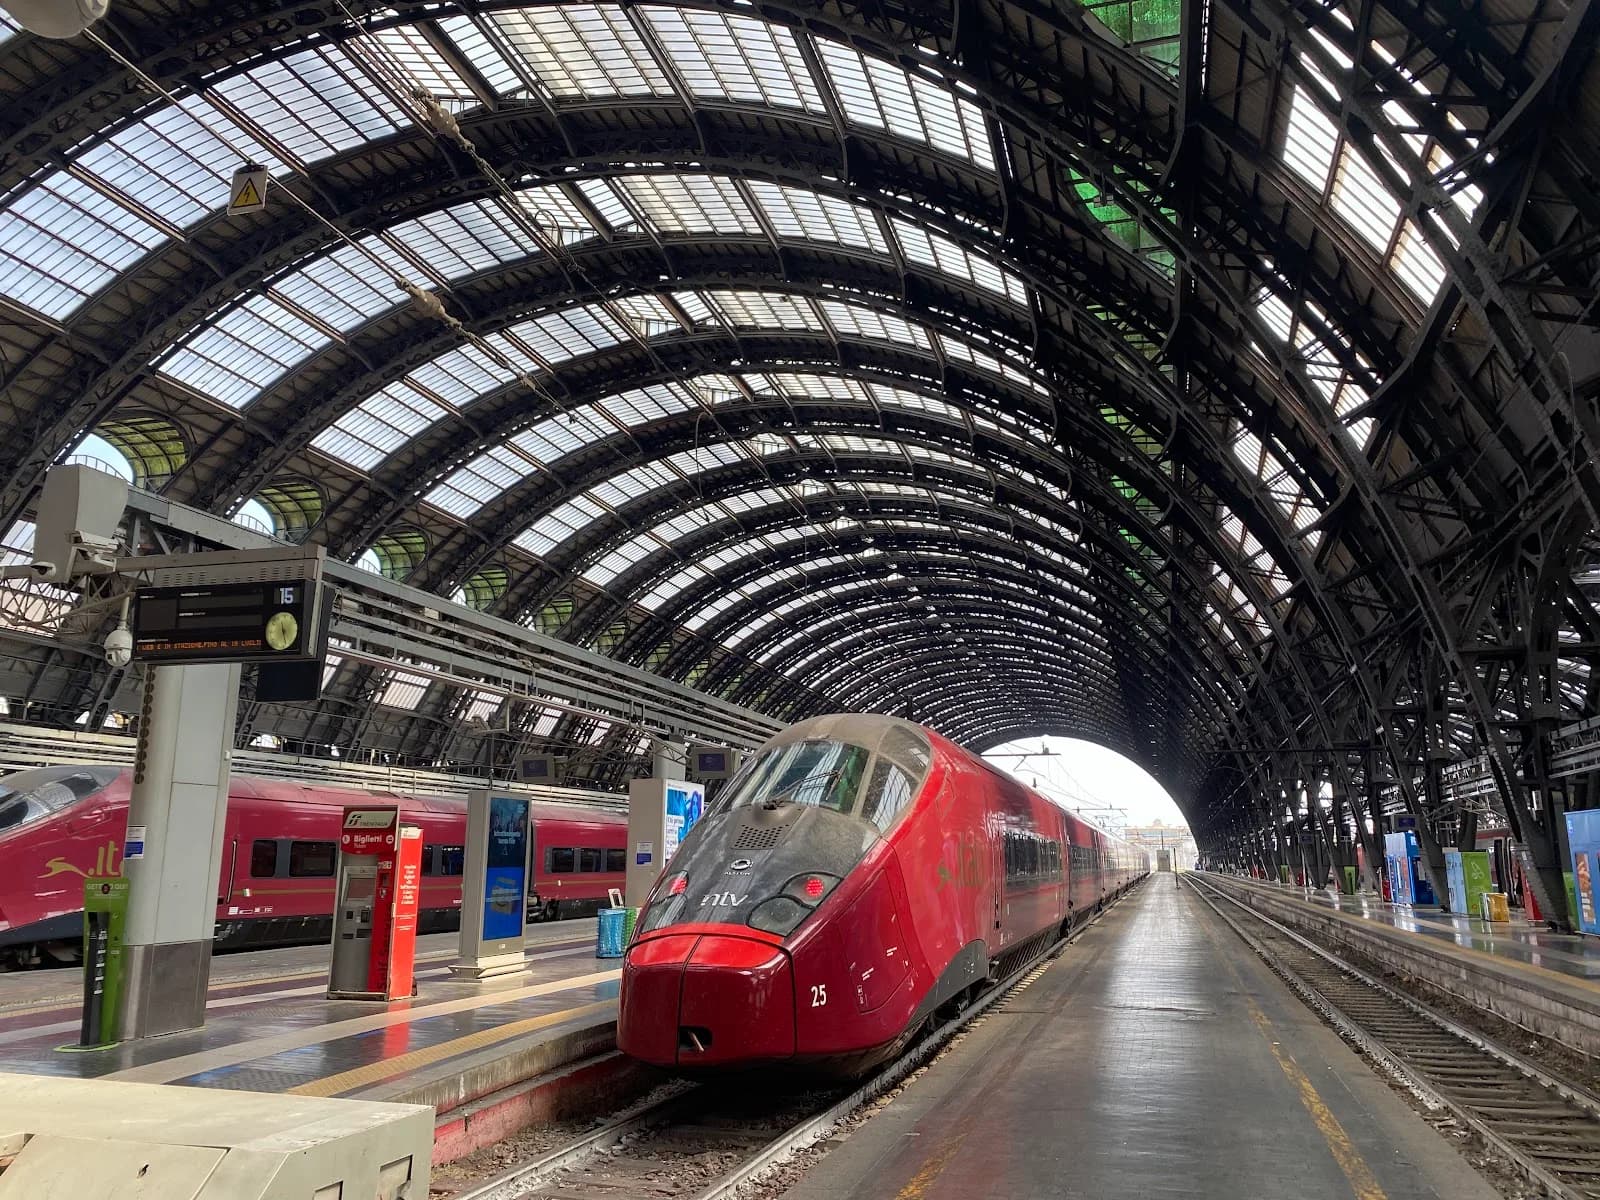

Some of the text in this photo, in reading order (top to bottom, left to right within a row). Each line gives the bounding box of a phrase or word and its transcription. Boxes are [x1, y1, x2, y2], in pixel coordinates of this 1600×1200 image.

[279, 587, 294, 604] 15
[353, 834, 382, 845] Biglietti
[700, 891, 749, 906] ntv
[810, 983, 827, 1008] 25
